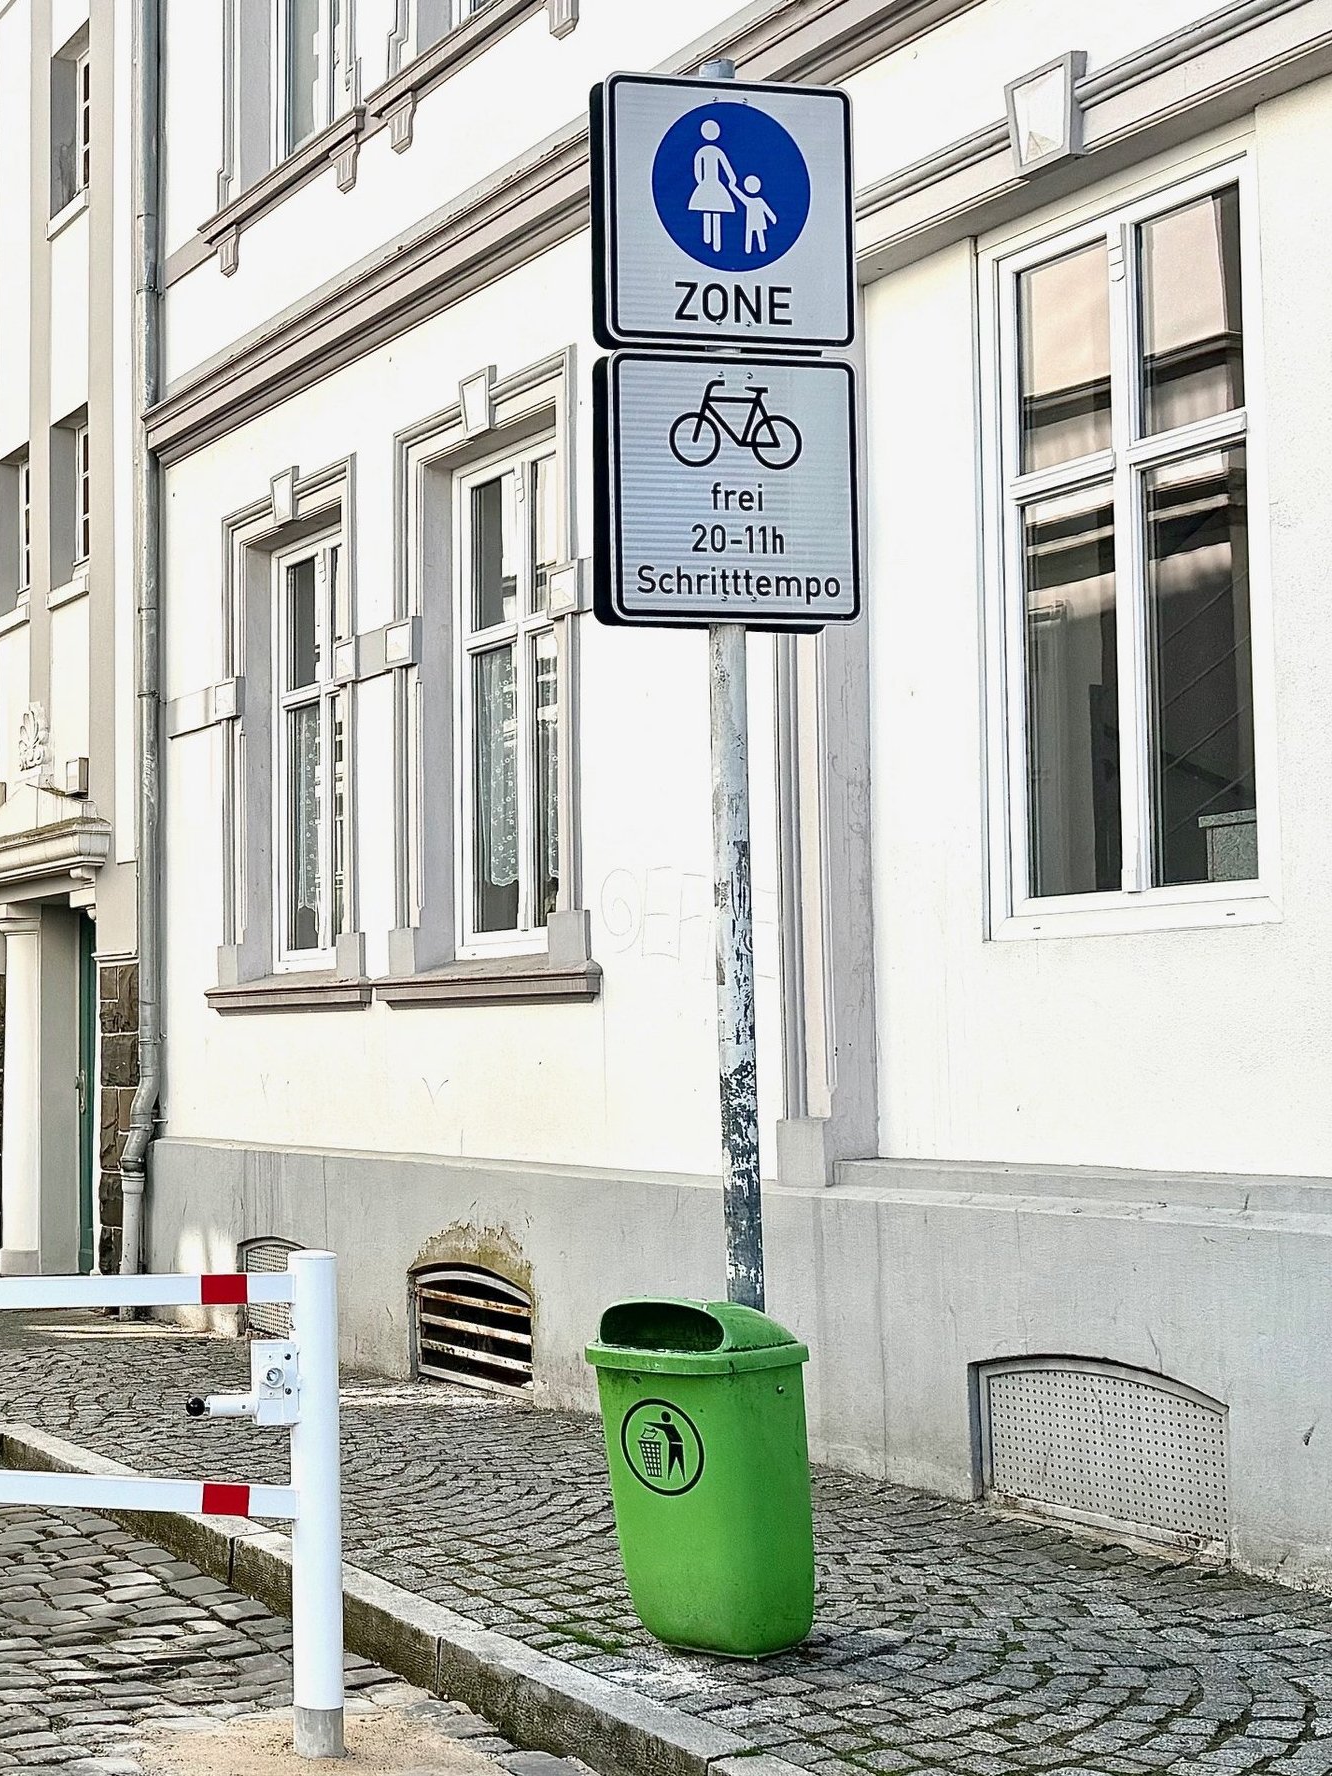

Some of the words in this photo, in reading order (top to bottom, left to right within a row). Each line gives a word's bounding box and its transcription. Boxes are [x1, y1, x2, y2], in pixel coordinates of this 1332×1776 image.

[674, 281, 793, 326] ZONE
[710, 481, 764, 512] frei
[691, 523, 785, 555] 20-11h
[636, 564, 841, 605] Schritttempo
